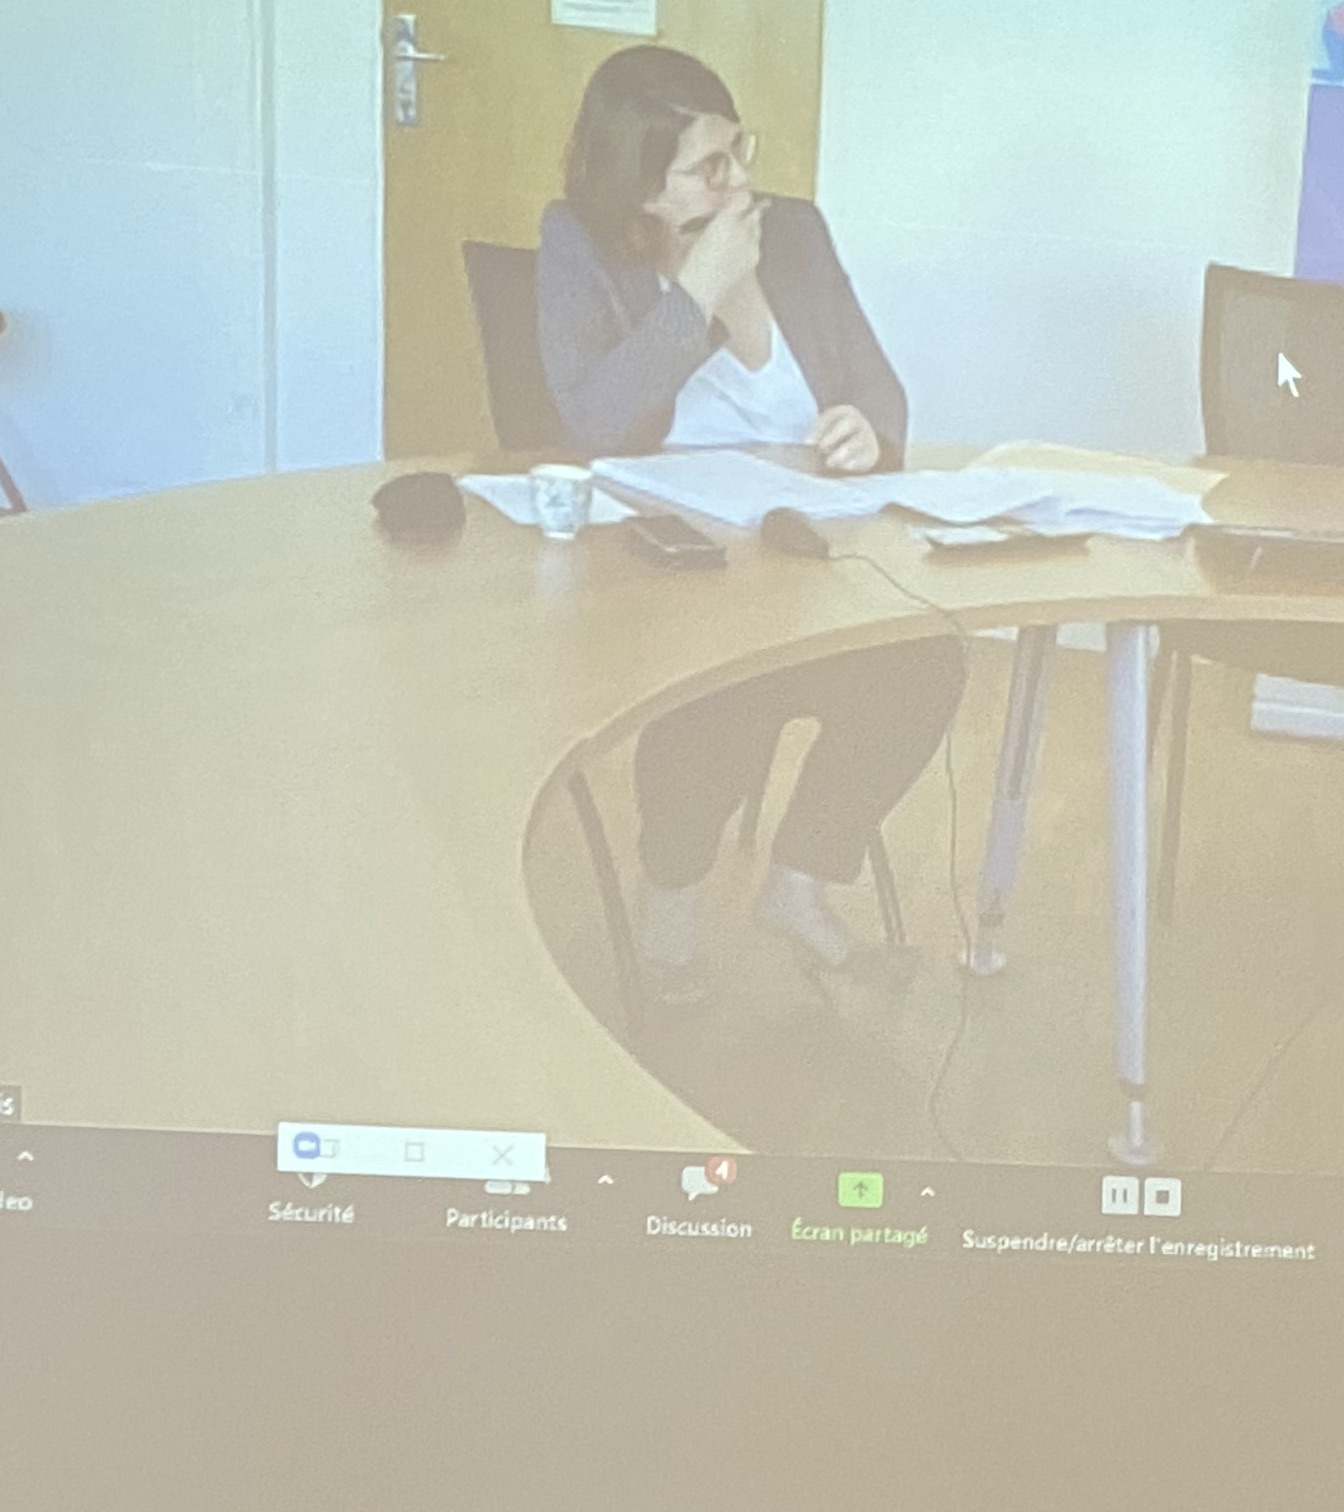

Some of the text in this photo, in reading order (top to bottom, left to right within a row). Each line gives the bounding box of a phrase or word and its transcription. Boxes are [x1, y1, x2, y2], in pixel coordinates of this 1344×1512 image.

[267, 1200, 355, 1224] Sécurité
[445, 1207, 569, 1233] Participants
[646, 1215, 753, 1238] Discussion
[790, 1216, 929, 1248] Écran partagé
